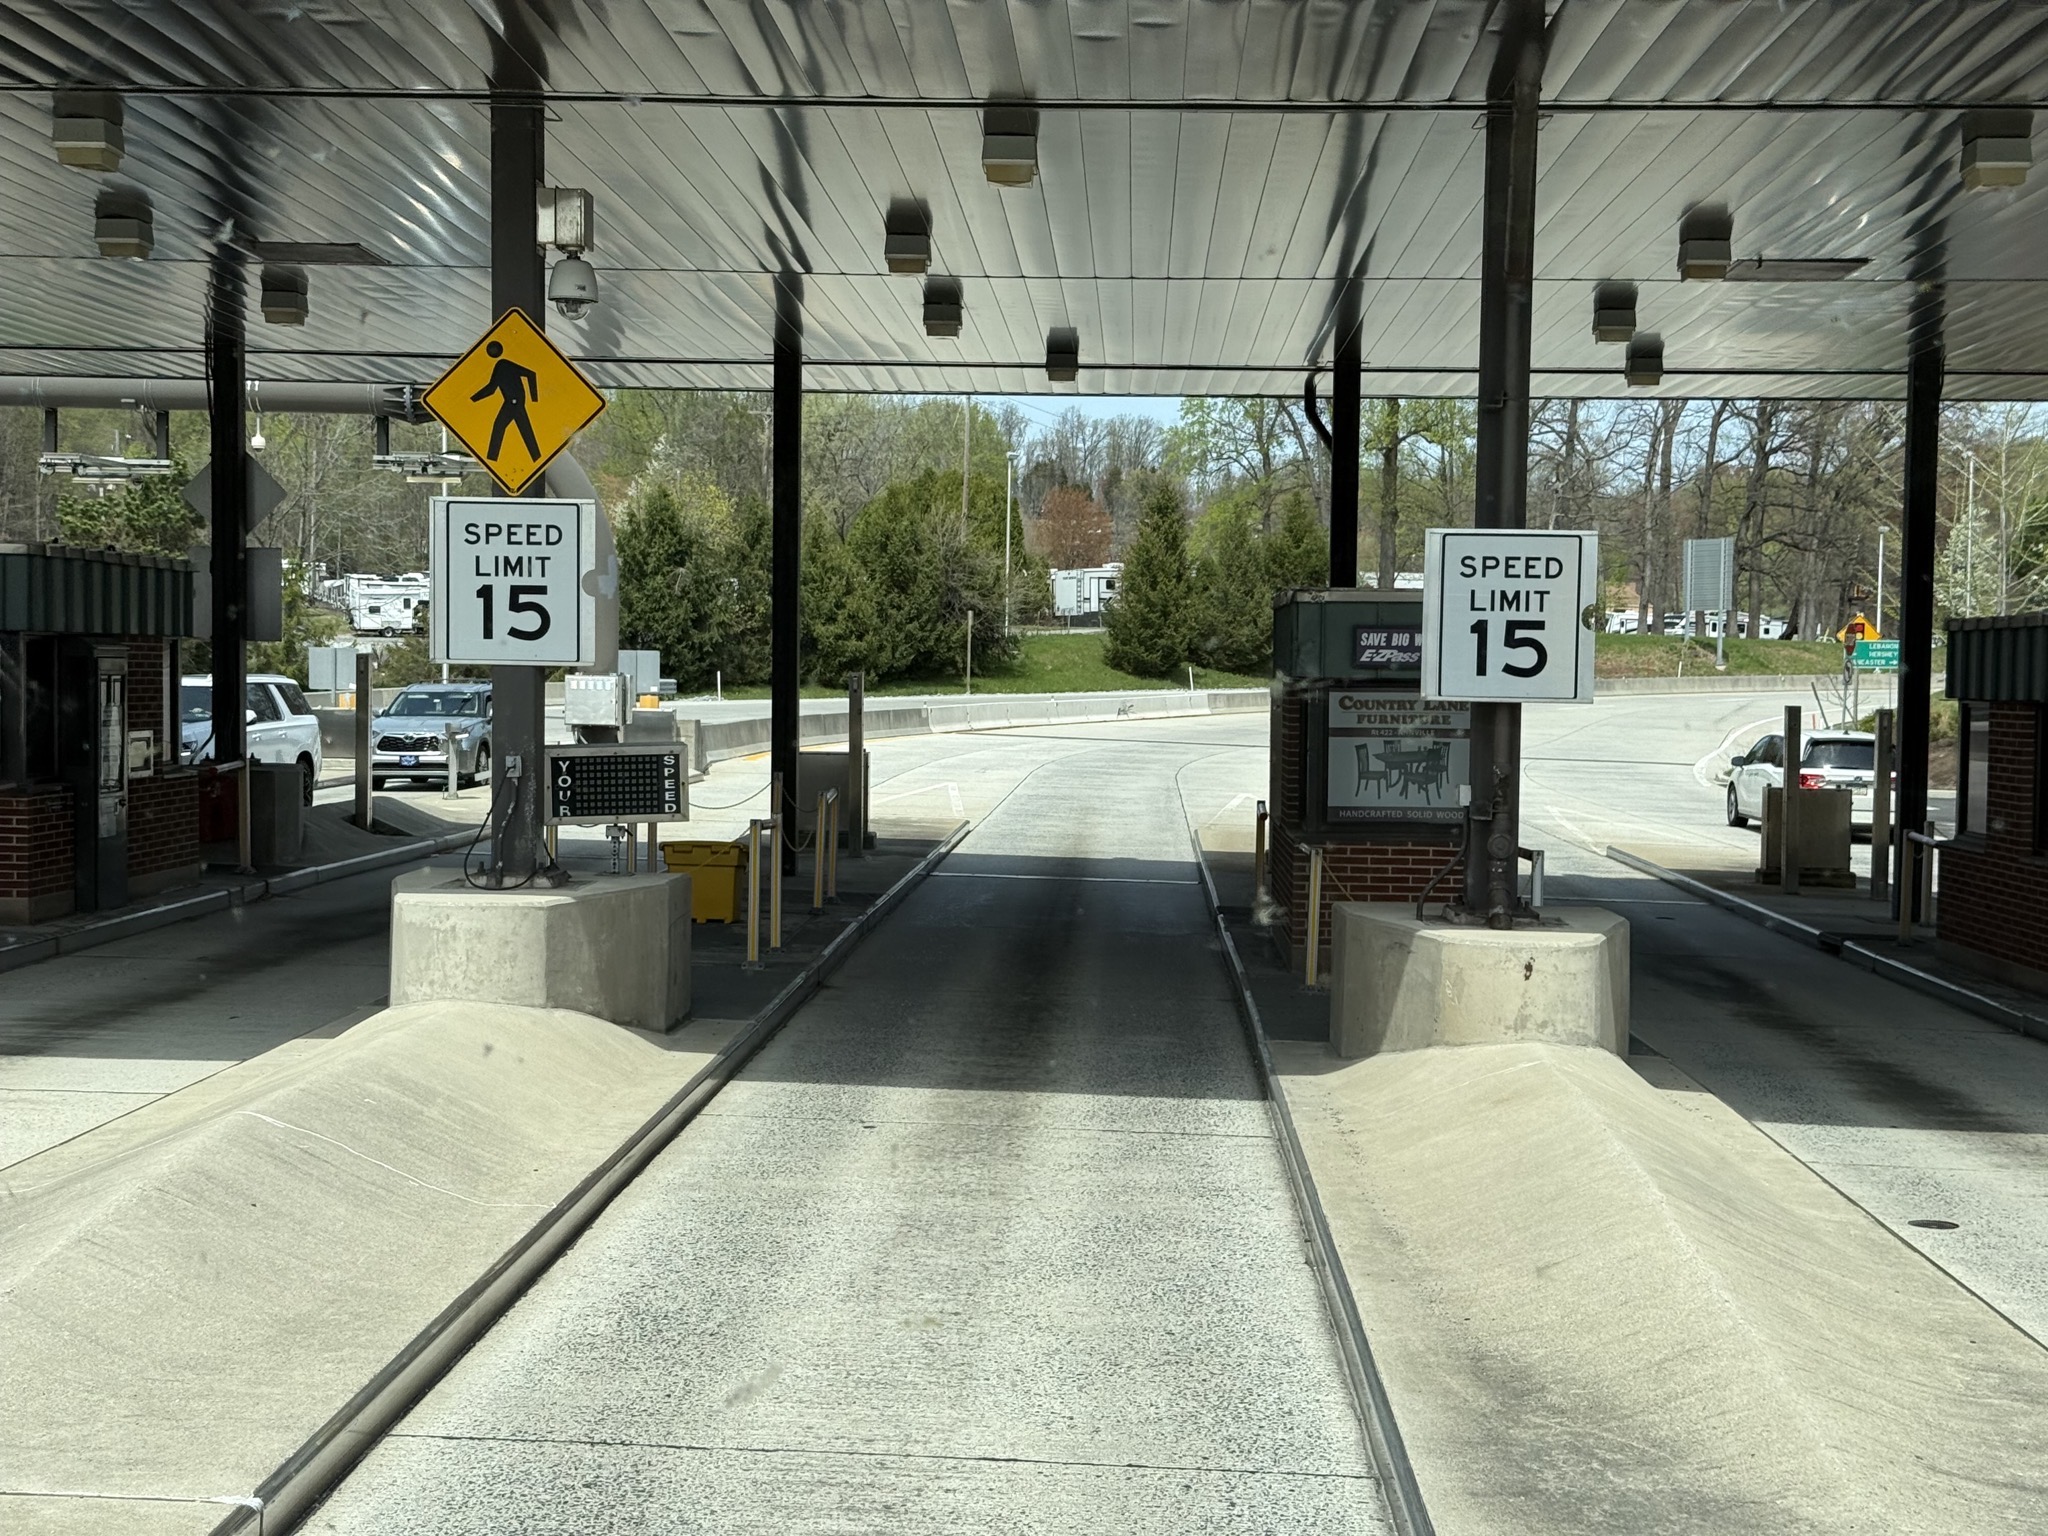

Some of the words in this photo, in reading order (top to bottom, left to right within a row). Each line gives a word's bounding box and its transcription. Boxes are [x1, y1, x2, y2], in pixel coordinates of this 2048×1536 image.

[464, 523, 562, 545] SPEED
[476, 556, 551, 577] LIMIT
[1460, 556, 1563, 579] SPEED
[1470, 590, 1550, 612] LIMIT
[476, 584, 550, 641] 15
[1360, 632, 1388, 646] SAVE
[1391, 632, 1410, 646] BIG
[1470, 619, 1547, 678] 15
[1360, 649, 1420, 662] E-ZPass
[1338, 695, 1419, 711] COUNTRY
[1422, 700, 1469, 712] LANE
[1356, 714, 1452, 725] FURNITURE
[558, 761, 571, 816] YOUR
[663, 755, 677, 813] SPEED
[1339, 810, 1403, 819] HANDCRAFTED
[1407, 811, 1433, 819] SOLID
[1436, 811, 1465, 819] WOOD
